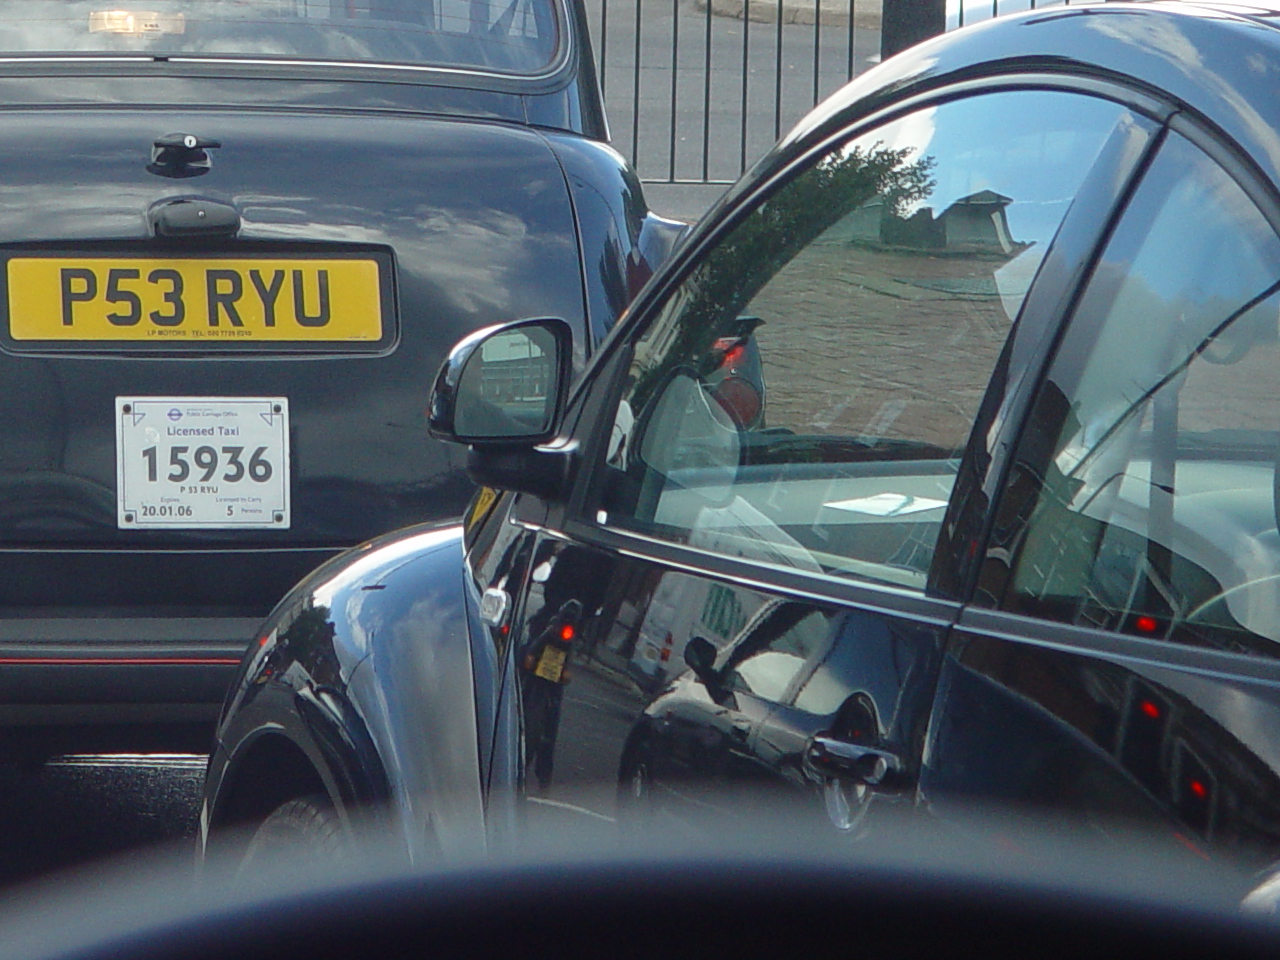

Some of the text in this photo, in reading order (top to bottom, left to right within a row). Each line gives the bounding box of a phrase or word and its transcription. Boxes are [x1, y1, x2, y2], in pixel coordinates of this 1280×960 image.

[60, 267, 332, 328] P53 RYU
[167, 426, 239, 436] Licensed Taxi
[142, 445, 273, 483] 15936
[200, 486, 219, 494] RYU
[141, 505, 193, 517] 20.01.06
[226, 505, 234, 517] 5
